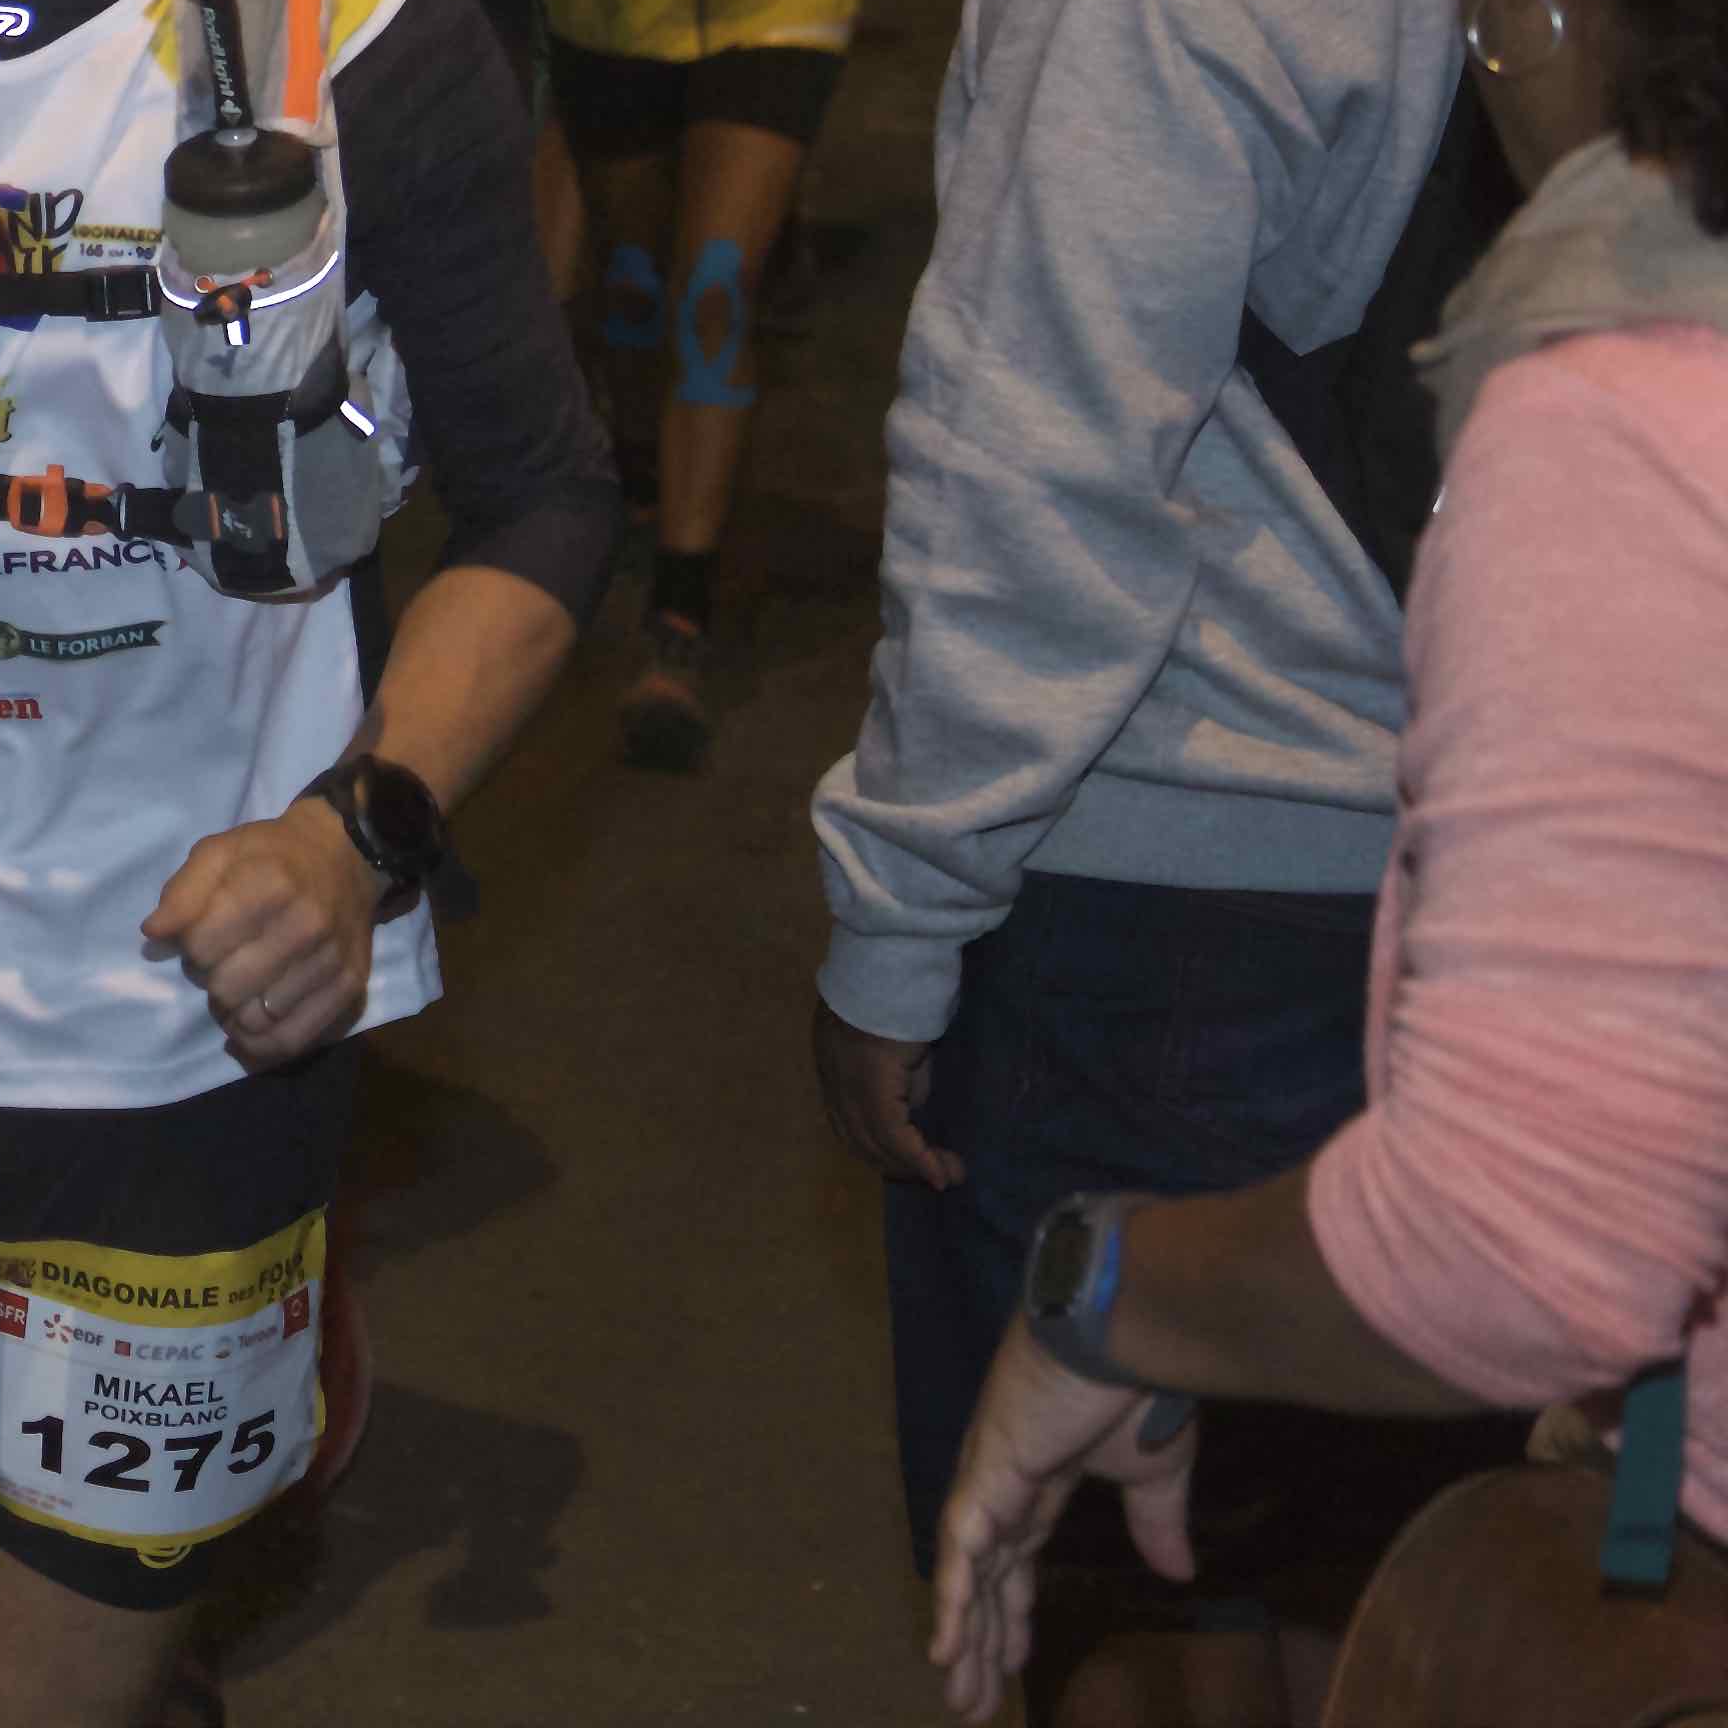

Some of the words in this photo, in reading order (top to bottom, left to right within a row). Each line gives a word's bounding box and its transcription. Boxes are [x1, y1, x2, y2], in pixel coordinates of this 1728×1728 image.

[29, 638, 52, 654] LE
[56, 629, 145, 657] FORBAN
[41, 1261, 219, 1310] DIAGONALE
[135, 1343, 206, 1362] CEPAC
[93, 1373, 224, 1408] MIKAEL
[83, 1400, 228, 1429] POIXBLANC
[20, 1409, 276, 1494] 1275
